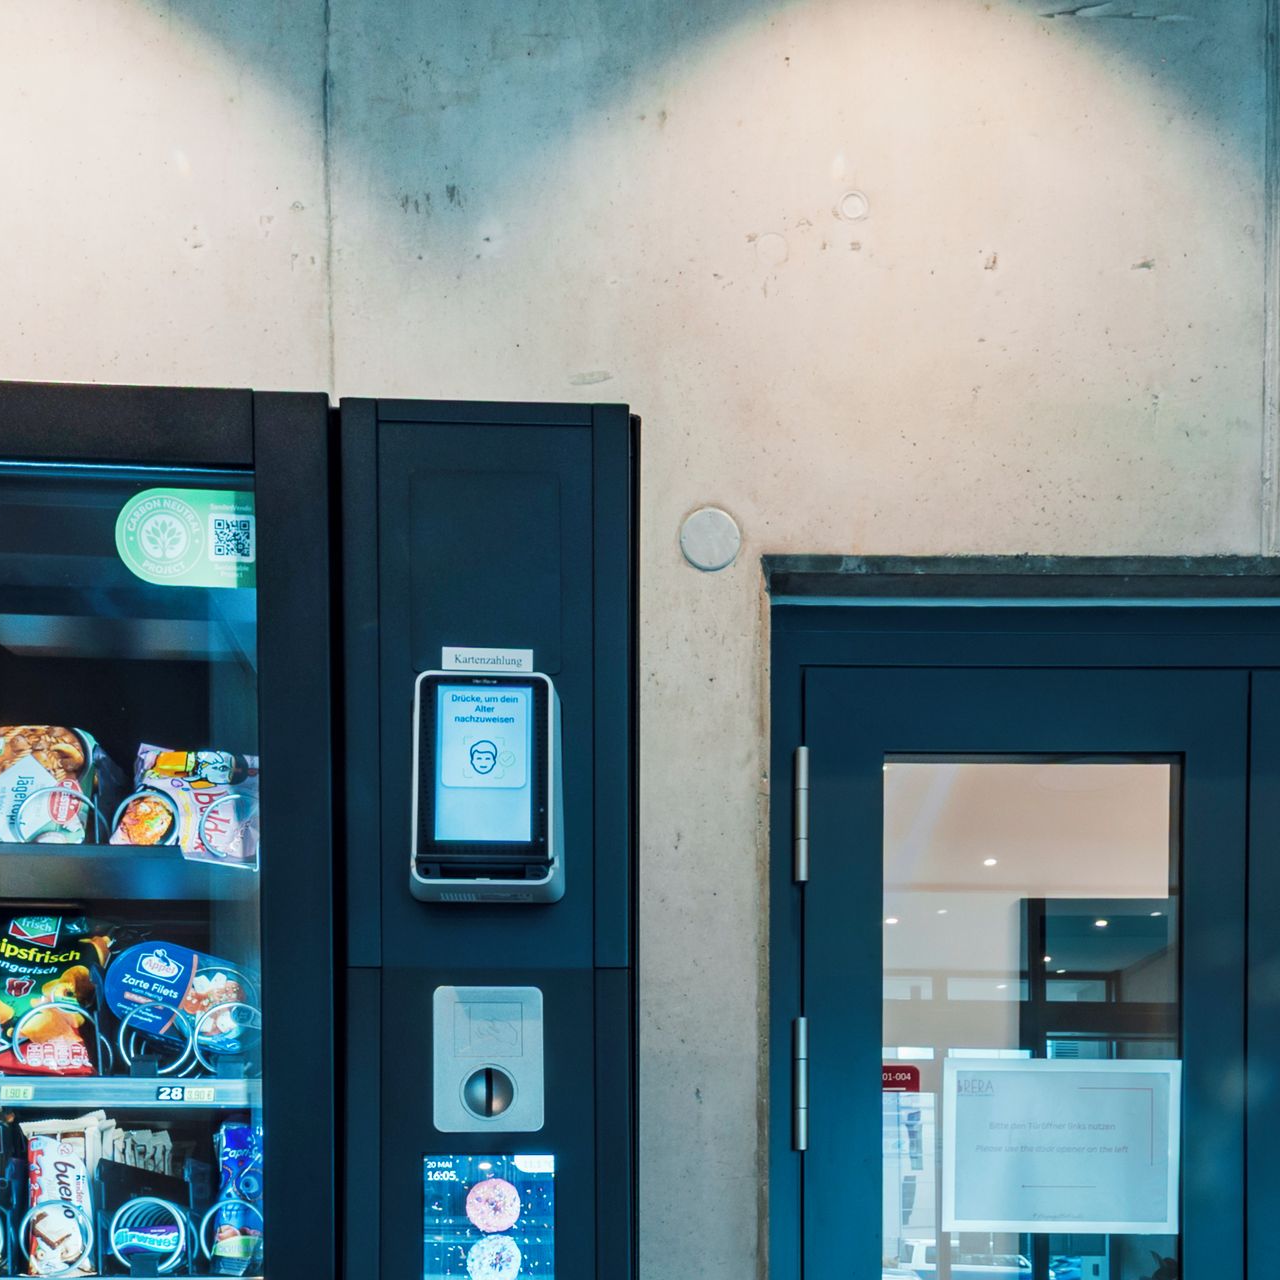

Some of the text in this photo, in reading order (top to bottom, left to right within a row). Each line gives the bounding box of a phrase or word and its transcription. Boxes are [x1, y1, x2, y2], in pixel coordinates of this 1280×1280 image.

[127, 499, 161, 533] CARBON
[142, 561, 185, 575] PROJECT
[453, 653, 523, 670] Kartenzahlung
[451, 694, 519, 704] Drücke, um dein
[474, 704, 495, 713] Alter
[454, 714, 515, 724] nachzuweisen
[21, 919, 52, 932] frisch
[122, 973, 179, 999] Zarte Filets
[882, 1072, 911, 1082] 01-004
[158, 1086, 183, 1101] 28
[989, 1121, 1116, 1131] Bitte den Türöffner links nutzen
[976, 1145, 1002, 1154] Please
[1004, 1146, 1018, 1154] use
[1020, 1145, 1034, 1154] the
[1035, 1145, 1054, 1154] door
[1056, 1147, 1085, 1156] opener
[1099, 1146, 1112, 1154] the
[1114, 1145, 1128, 1154] left
[426, 1161, 453, 1169] 20 MAI
[427, 1171, 456, 1181] 16:05
